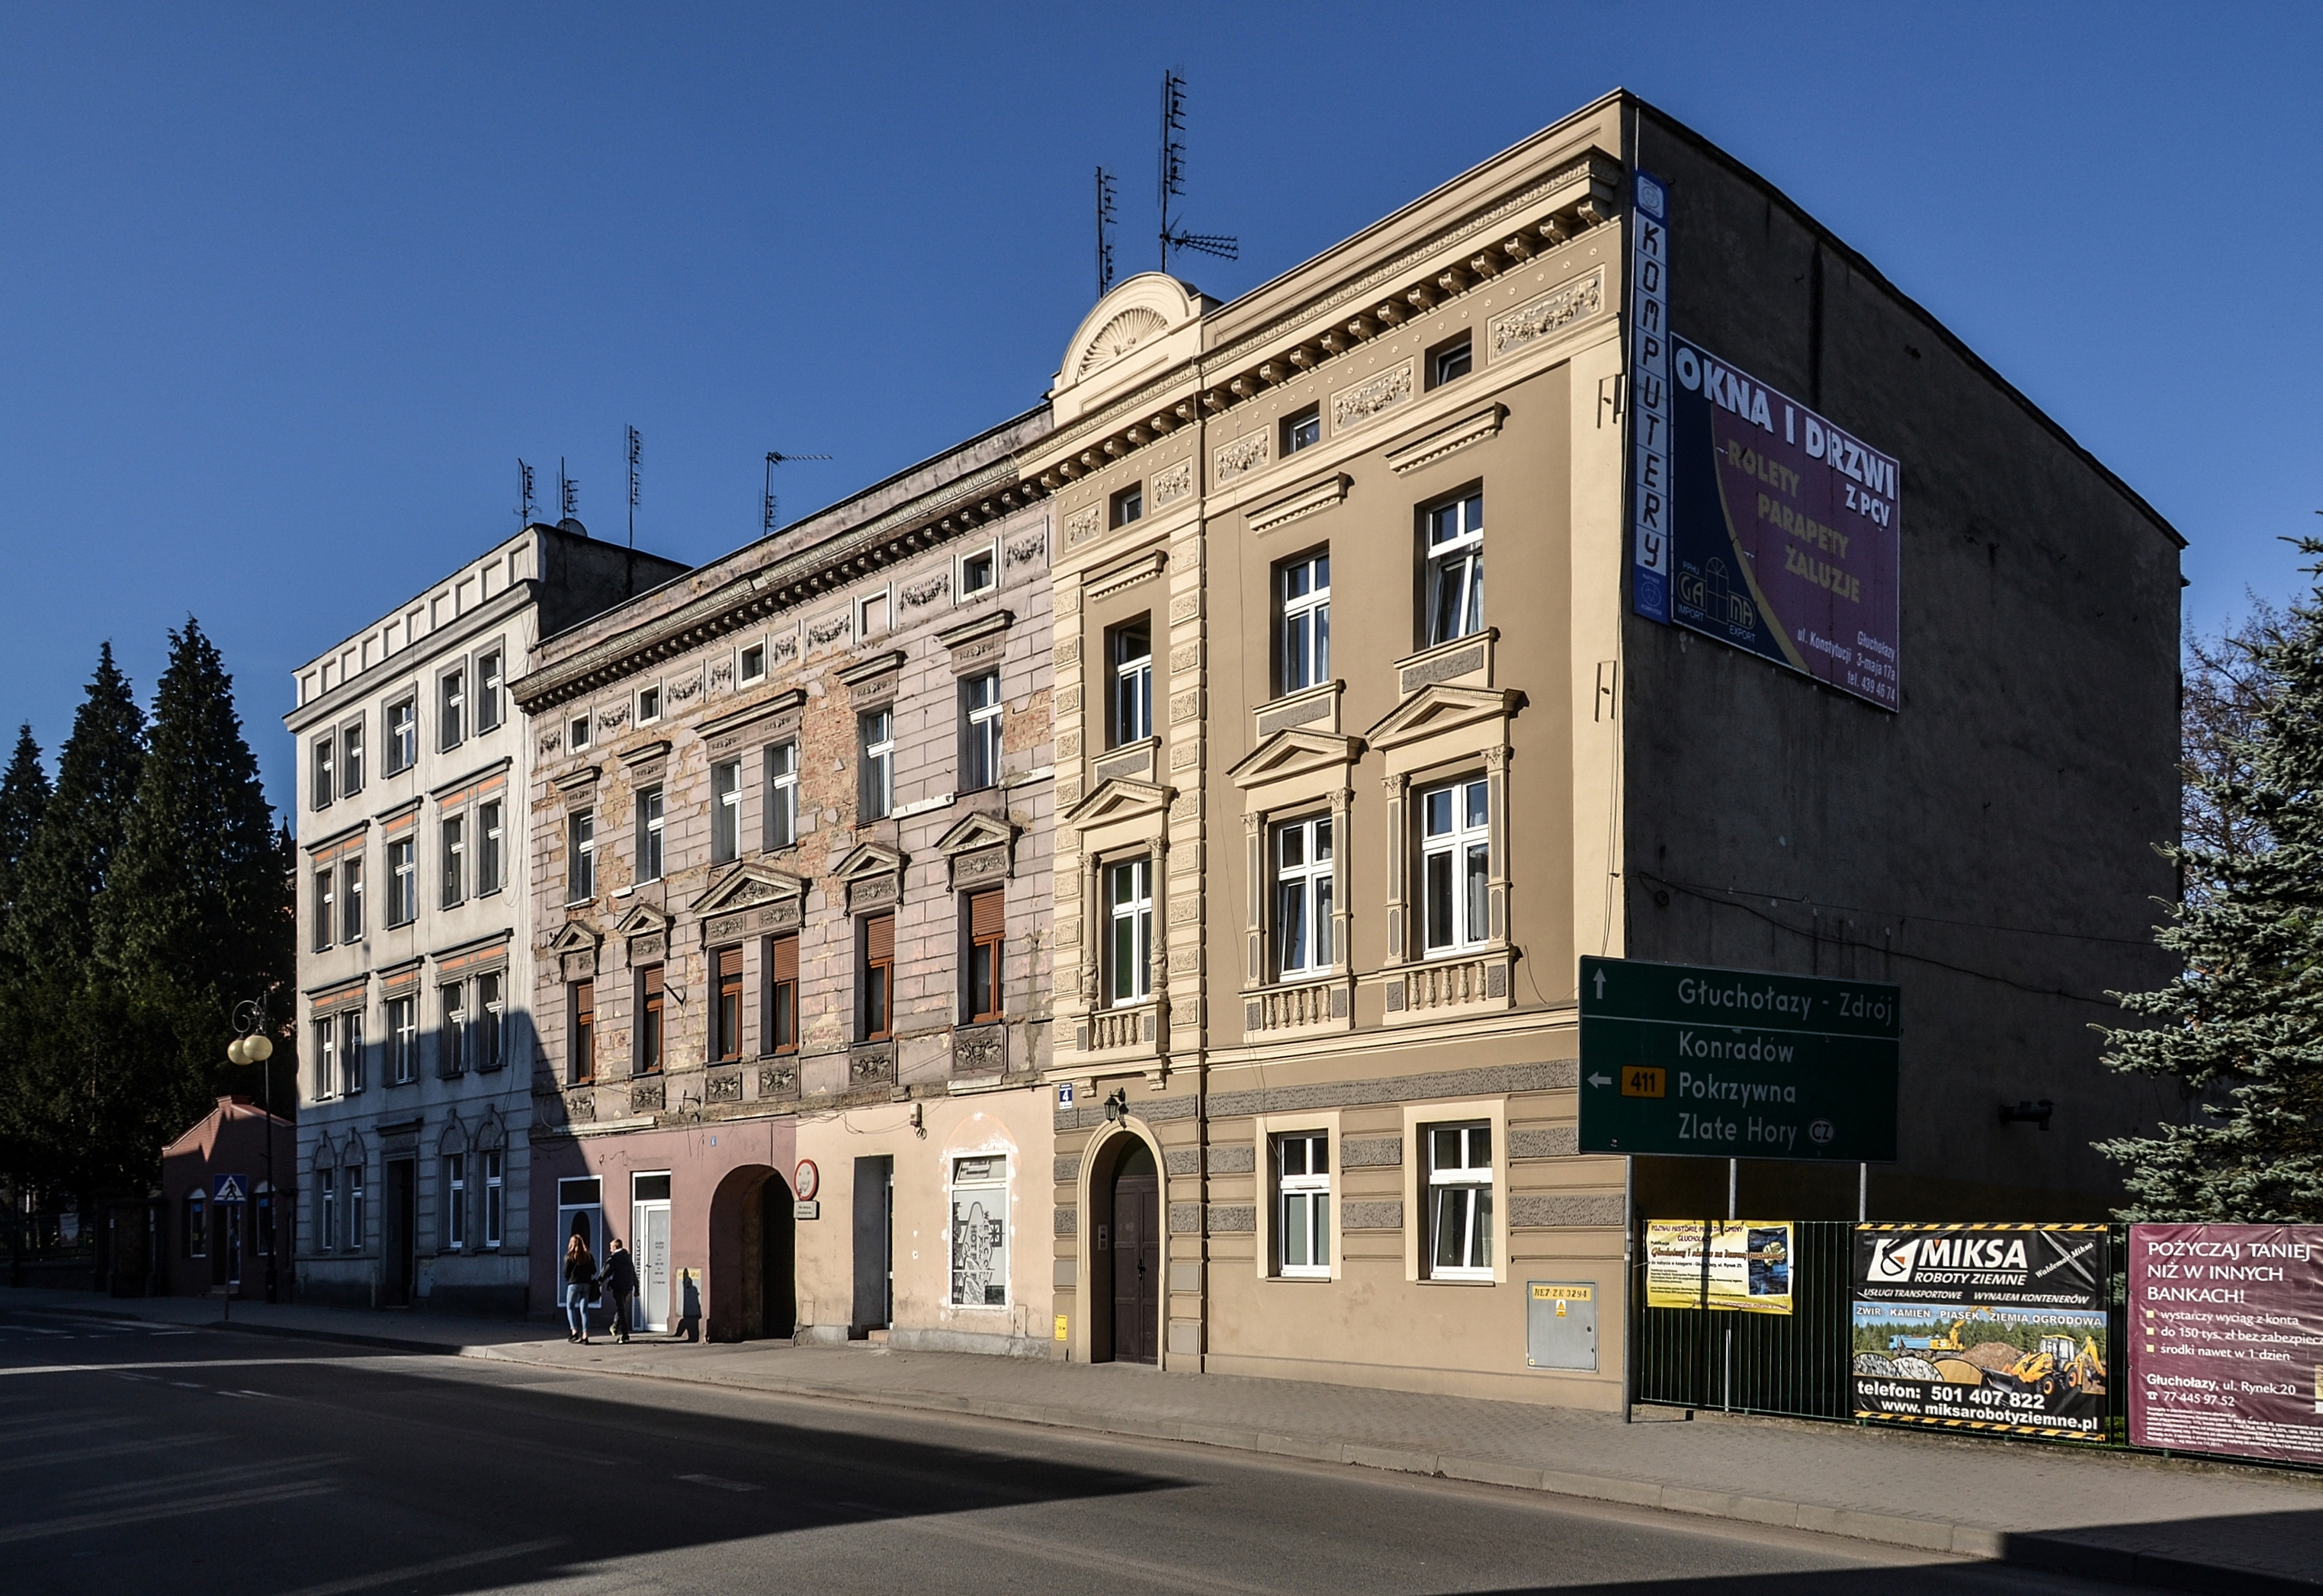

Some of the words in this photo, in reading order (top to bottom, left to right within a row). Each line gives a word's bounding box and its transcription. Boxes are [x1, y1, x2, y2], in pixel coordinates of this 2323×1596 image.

[1642, 221, 1660, 567] KOMPUTERY
[1676, 347, 1774, 434] OKNA
[1786, 405, 1795, 445] I
[1805, 416, 1895, 501] DRZWI
[1728, 438, 1800, 497] ROLETY
[1846, 483, 1857, 511] Z
[1860, 492, 1891, 528] PCV
[1757, 492, 1850, 559] PARAPETY
[1683, 561, 1700, 575] PPHU
[1678, 604, 1705, 622] IMPORT
[1729, 625, 1756, 643] EXPORT
[1798, 628, 1808, 644] ul.
[1810, 631, 1852, 665] Konstytucji
[1883, 664, 1896, 681] 17a
[1857, 631, 1896, 663] Głuchołazy
[1847, 671, 1859, 687] tel.
[1861, 676, 1875, 694] 439
[1876, 682, 1885, 698] 46
[1887, 687, 1896, 702] 74
[1678, 978, 1812, 1021] Głuchołazy
[1840, 992, 1893, 1027] Zdrój
[1679, 1030, 1794, 1063] Konradów
[1062, 1090, 1069, 1102] 4
[1630, 1071, 1655, 1092] 411
[1679, 1072, 1796, 1108] Pokrzywna
[1679, 1113, 1737, 1142] Zlate
[1748, 1117, 1797, 1150] Hory
[1812, 1123, 1830, 1140] CZ
[1918, 1239, 2029, 1269] MIKSA
[2071, 1242, 2094, 1258] Miksa
[2148, 1239, 2240, 1261] POŻYCZAJ
[2247, 1243, 2311, 1262] TANIEJ
[1914, 1272, 1971, 1284] ROBOTY
[1971, 1273, 2027, 1286] ZIEMNE
[2148, 1261, 2179, 1280] NIŻ
[2183, 1265, 2205, 1280] W
[2209, 1266, 2283, 1282] INNYCH
[1863, 1288, 1895, 1297] USŁUGI
[1895, 1289, 1963, 1300] TRANSPORTOWE
[1973, 1291, 2020, 1302] WYNAJEM
[2020, 1293, 2090, 1305] KONTENERÓW
[2148, 1287, 2245, 1304] BANKACH!
[1940, 1310, 1980, 1320] PIASEK
[1989, 1312, 2029, 1322] ZIEMIA
[2033, 1314, 2103, 1326] OGRODOWA
[2161, 1311, 2212, 1323] wystarczy
[2216, 1313, 2253, 1326] wyciąg
[2256, 1316, 2264, 1325] z
[2265, 1314, 2299, 1325] konta
[2161, 1327, 2176, 1338] do
[2179, 1327, 2199, 1338] 150
[2202, 1329, 2222, 1341] tys.
[2225, 1328, 2235, 1340] zł
[2238, 1331, 2258, 1342] bez
[2161, 1343, 2195, 1355] środki
[2198, 1347, 2232, 1358] nawet
[2235, 1350, 2244, 1358] w
[2248, 1348, 2254, 1358] 1
[2259, 1348, 2290, 1362] dzień
[1857, 1381, 1921, 1399] telefon:
[1931, 1386, 1962, 1402] 501
[1969, 1389, 2003, 1405] 407
[2009, 1392, 2045, 1409] 822
[2147, 1373, 2219, 1391] Głuchołazy,
[2222, 1380, 2238, 1390] ul.
[2241, 1382, 2277, 1396] Rynek
[2280, 1384, 2296, 1396] 20
[2163, 1391, 2178, 1402] 77
[2180, 1392, 2201, 1404] 445
[2204, 1394, 2218, 1405] 97
[2221, 1396, 2235, 1407] 52
[1925, 1404, 2098, 1431] miksarobotyziemne.pl
